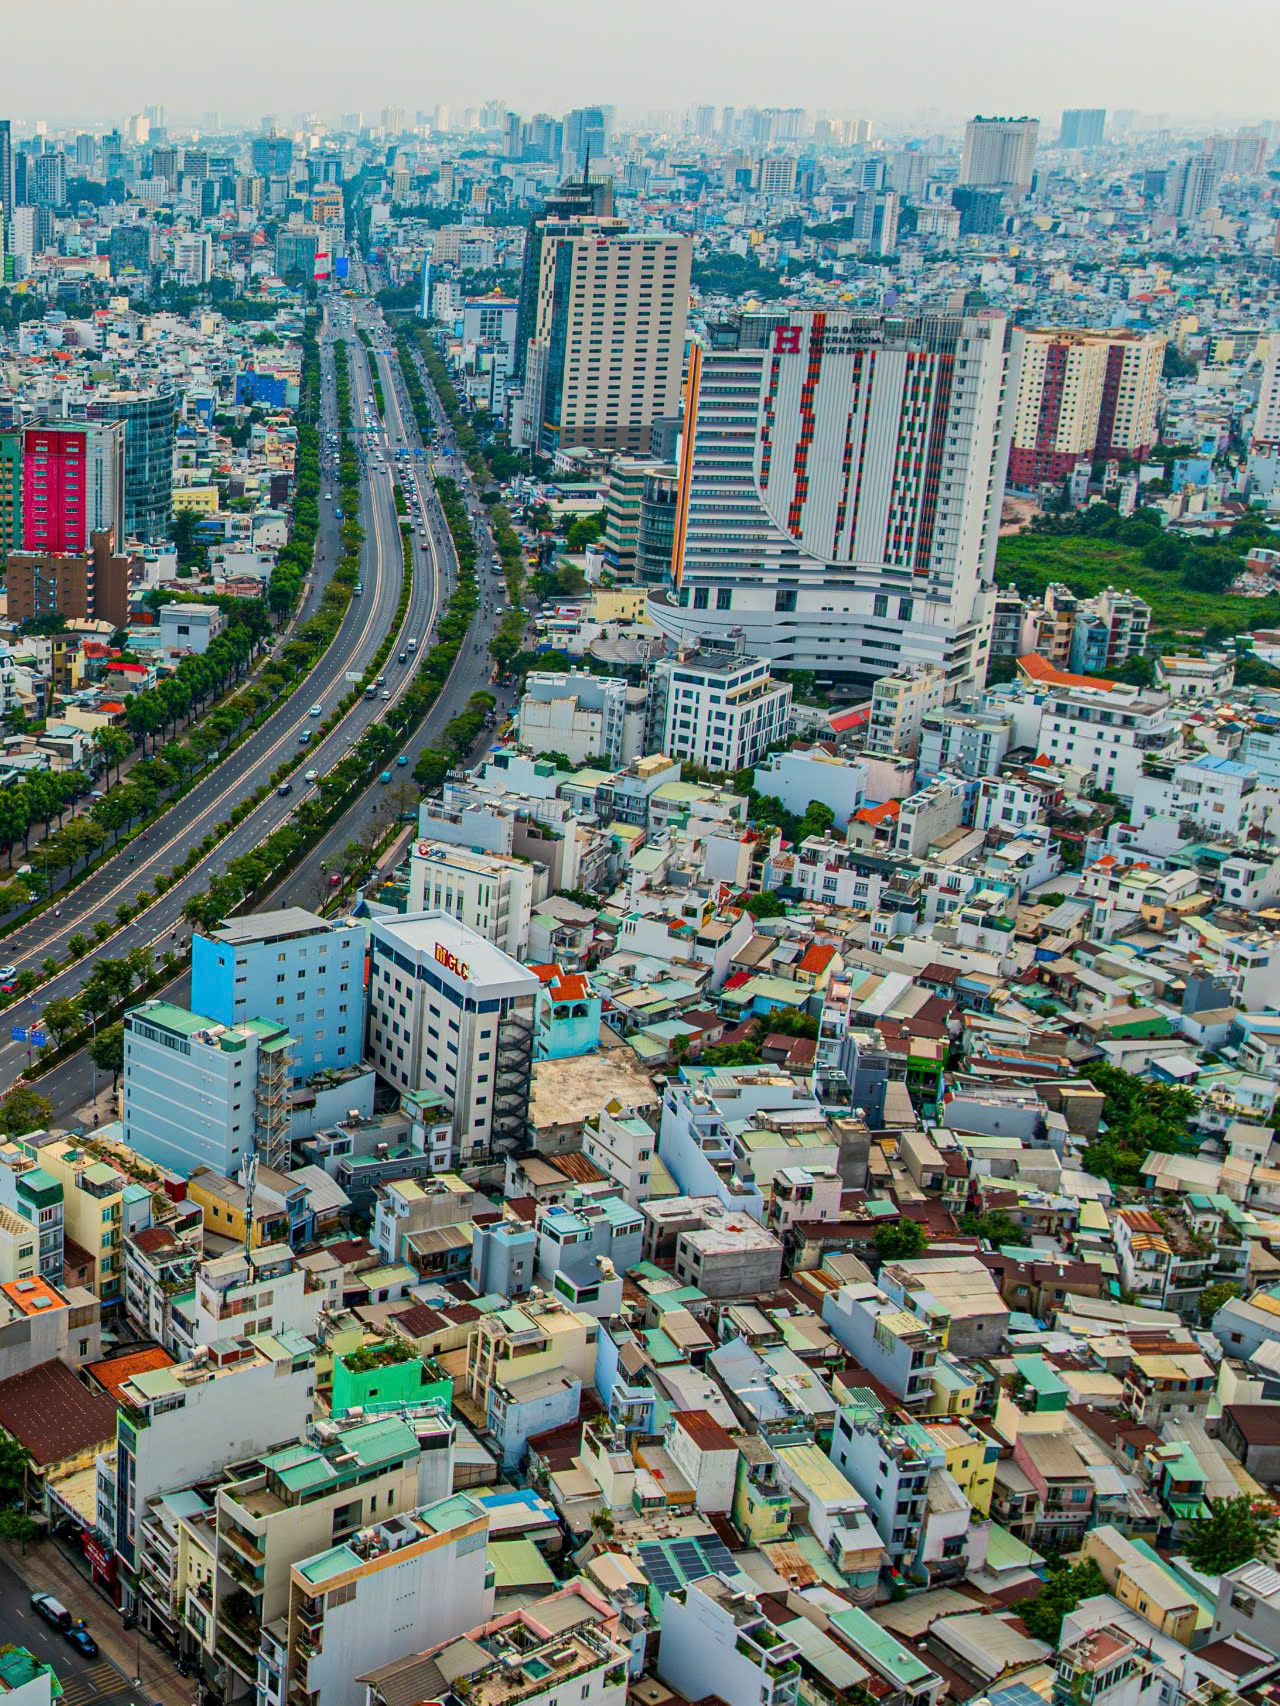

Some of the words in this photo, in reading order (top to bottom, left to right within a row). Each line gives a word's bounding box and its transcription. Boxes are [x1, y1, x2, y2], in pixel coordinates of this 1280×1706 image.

[773, 325, 803, 354] H
[809, 336, 887, 345] INTERNATIONAL
[809, 346, 870, 355] UNIVERSITY
[445, 769, 464, 779] ARGO
[429, 848, 447, 859] SCB
